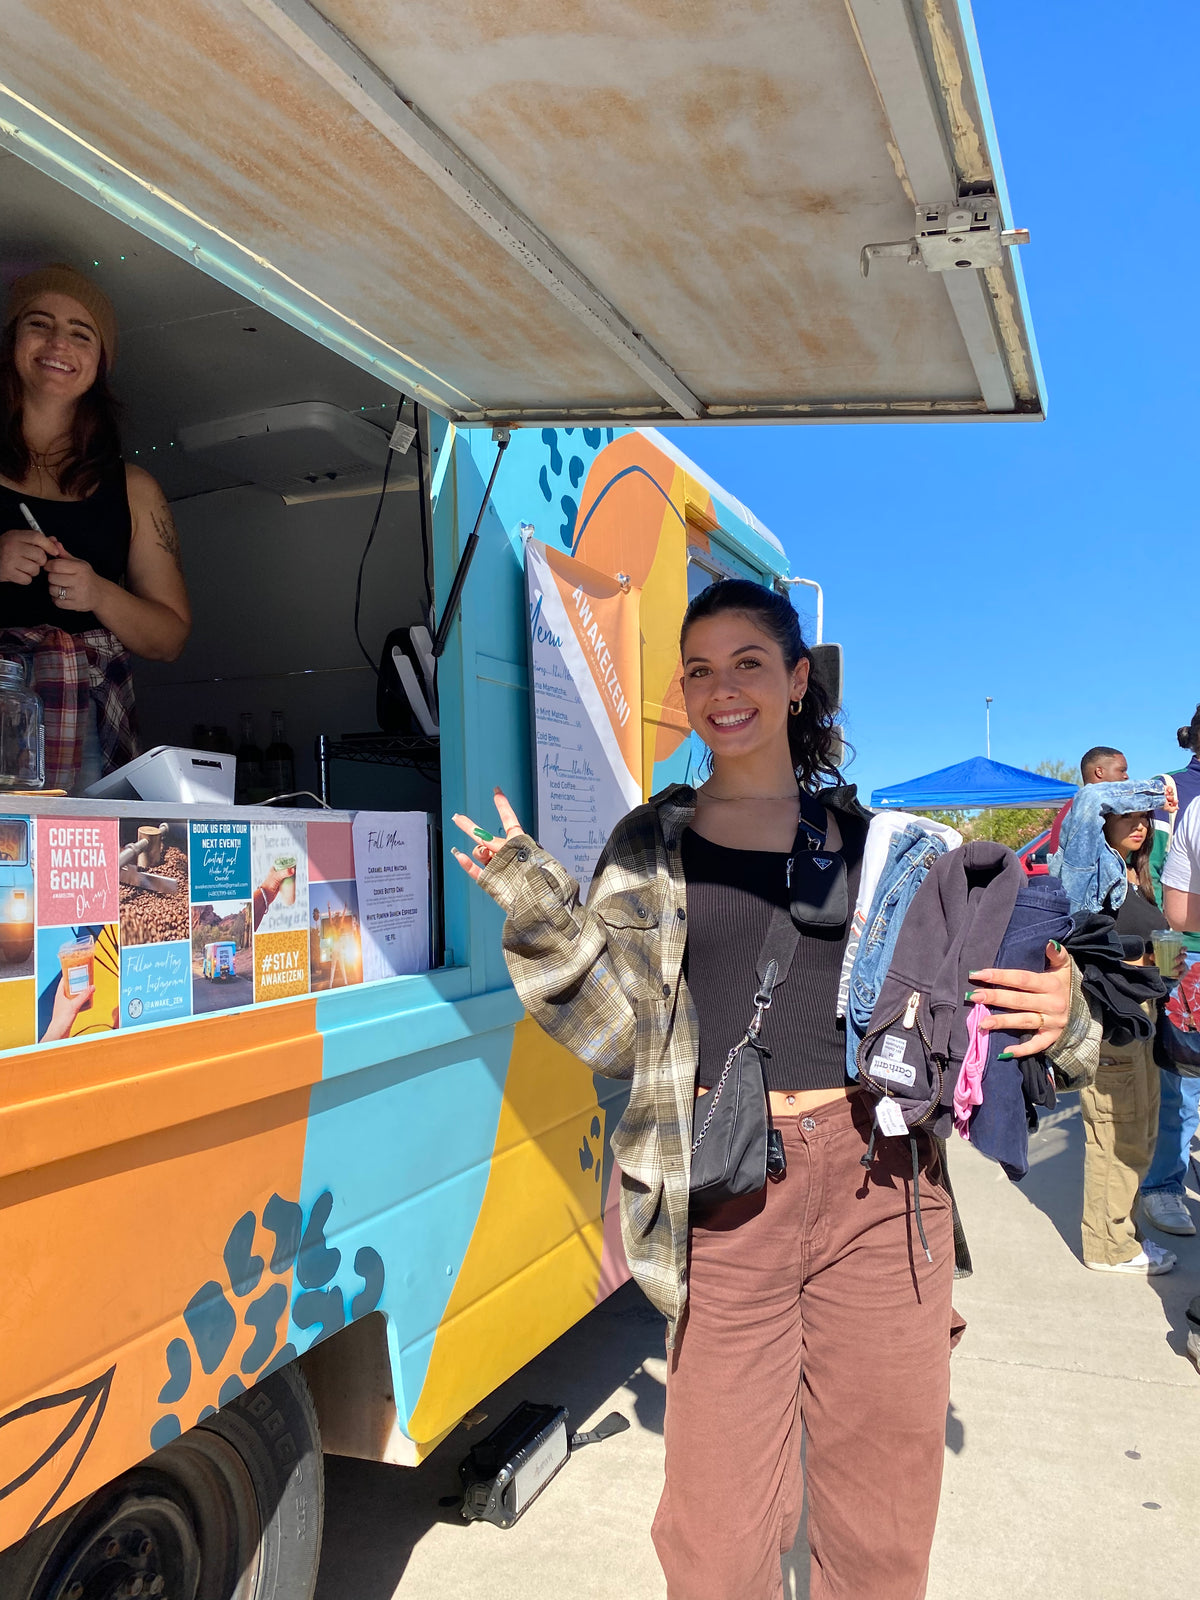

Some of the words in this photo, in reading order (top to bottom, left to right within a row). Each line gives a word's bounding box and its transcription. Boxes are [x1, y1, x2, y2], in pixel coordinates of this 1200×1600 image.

[572, 584, 631, 727] AWAKE(ZEN)
[537, 731, 547, 741] Cold
[550, 781, 560, 789] Iced
[561, 781, 575, 790] Coffee
[551, 792, 576, 801] Americano
[551, 802, 563, 811] Latte
[551, 814, 567, 822] Mocha
[193, 823, 209, 834] BOOK
[210, 824, 218, 834] US
[219, 824, 231, 834] FOR
[232, 824, 248, 834] YOUR
[49, 828, 104, 848] COFFEE,
[202, 839, 218, 849] NEXT
[368, 830, 384, 853] Fall
[386, 830, 405, 850] Menu
[50, 849, 107, 868] MATCHA
[203, 848, 226, 867] Contact
[77, 887, 91, 919] Oh
[127, 953, 153, 977] Follow
[261, 950, 300, 973] #STAY
[260, 970, 304, 988] AWAKE(ZEN)
[144, 996, 184, 1011] @AWAKE_ZEN
[874, 1060, 912, 1078] Carhartt
